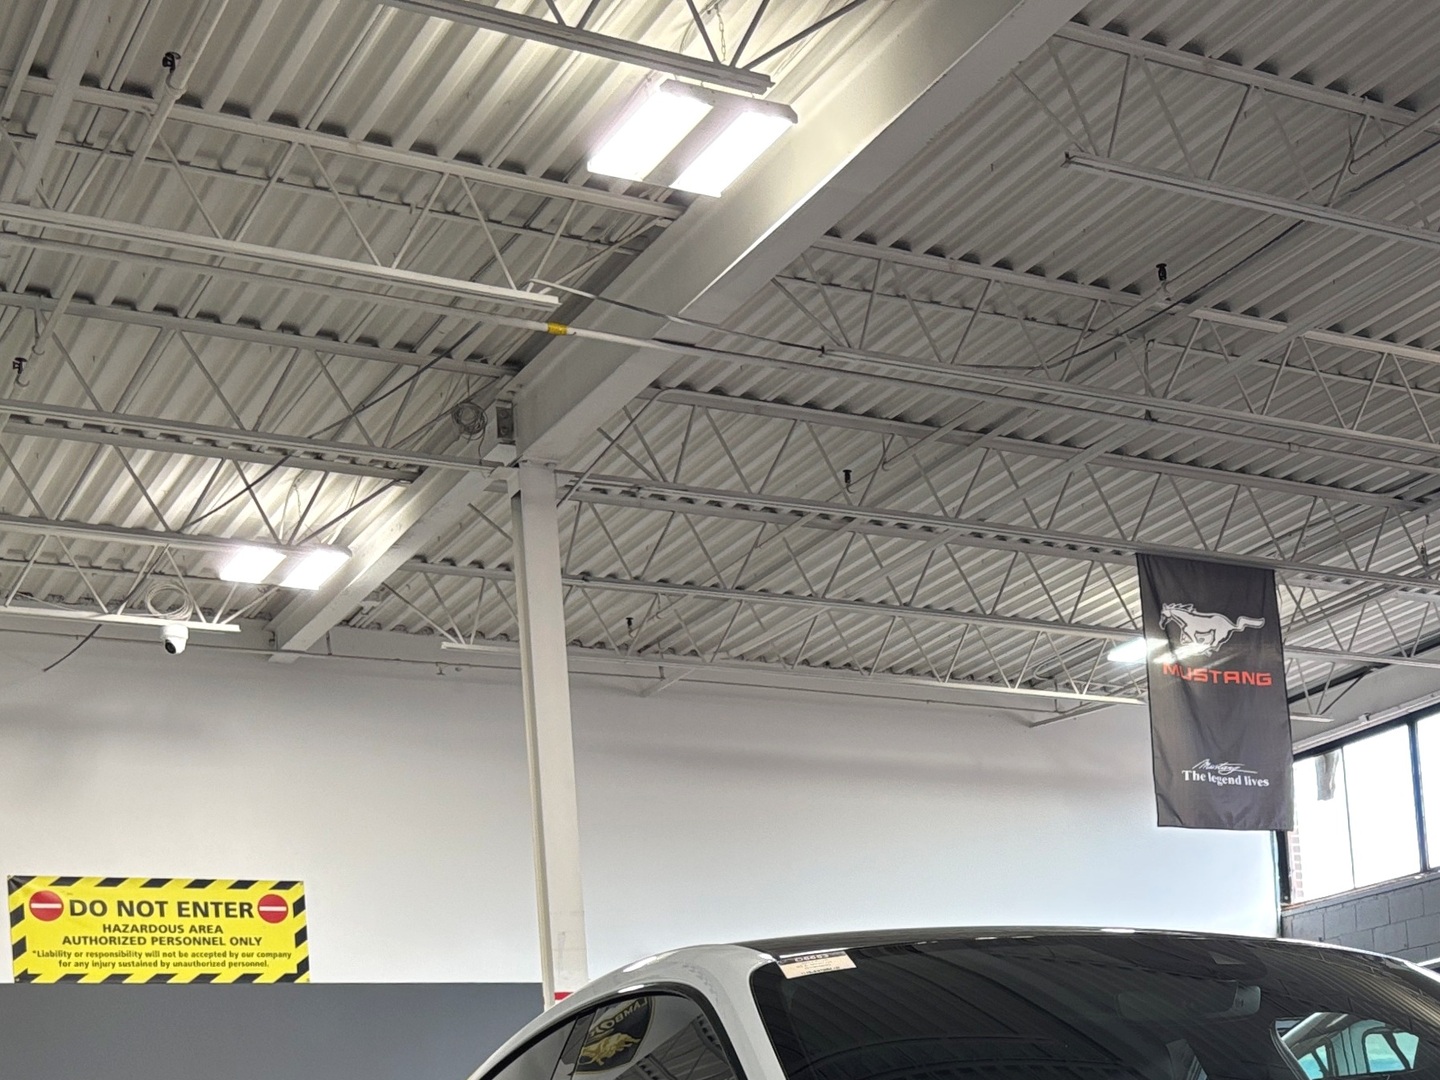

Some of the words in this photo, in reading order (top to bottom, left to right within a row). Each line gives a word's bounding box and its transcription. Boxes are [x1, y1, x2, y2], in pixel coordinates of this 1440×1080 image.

[1163, 662, 1273, 687] MUSTANG
[1181, 769, 1206, 782] The
[1207, 772, 1241, 786] legend
[1244, 776, 1270, 787] lives
[69, 899, 108, 917] DO
[117, 900, 168, 918] NOT
[177, 901, 254, 919] ENTER
[103, 923, 185, 934] HAZARDOUS
[189, 924, 224, 934] AREA
[62, 935, 147, 946] AUTHORIZED
[151, 936, 226, 946] PERSONNEL
[229, 936, 263, 946] ONLY
[86, 950, 143, 960] responsibility
[145, 950, 160, 958] will
[162, 950, 176, 959] not
[178, 950, 188, 958] be
[191, 951, 227, 960] accepted
[229, 950, 239, 960] by
[256, 952, 292, 960] company
[58, 960, 72, 968] for
[73, 961, 89, 969] any
[91, 960, 116, 969] injury
[118, 960, 157, 968] sustained
[160, 960, 170, 969] by
[173, 960, 226, 968] unauthorized
[228, 960, 269, 969] personnel.
